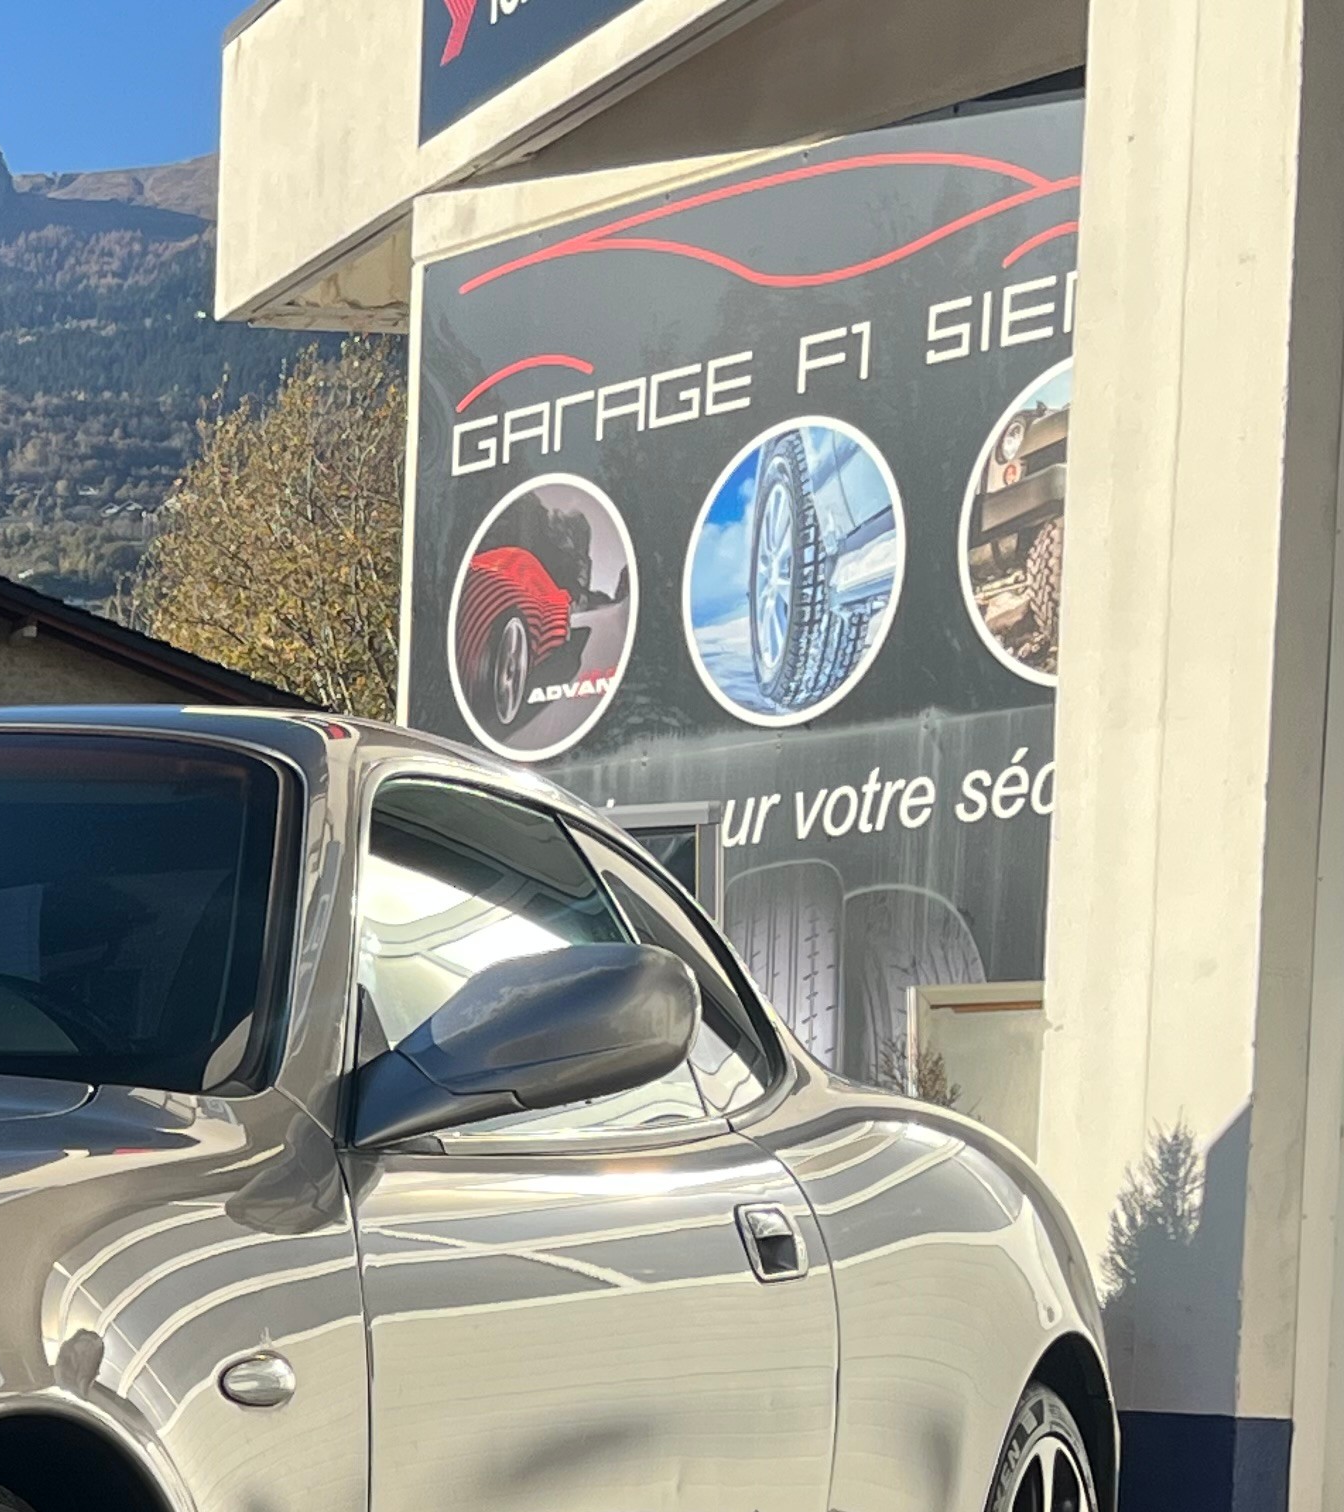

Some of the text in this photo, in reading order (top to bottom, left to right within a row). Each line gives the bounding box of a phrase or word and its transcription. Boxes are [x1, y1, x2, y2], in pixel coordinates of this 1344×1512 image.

[451, 350, 753, 477] GARAGE
[797, 320, 871, 394] F1
[527, 676, 616, 704] ADVAN
[795, 766, 936, 841] votre
